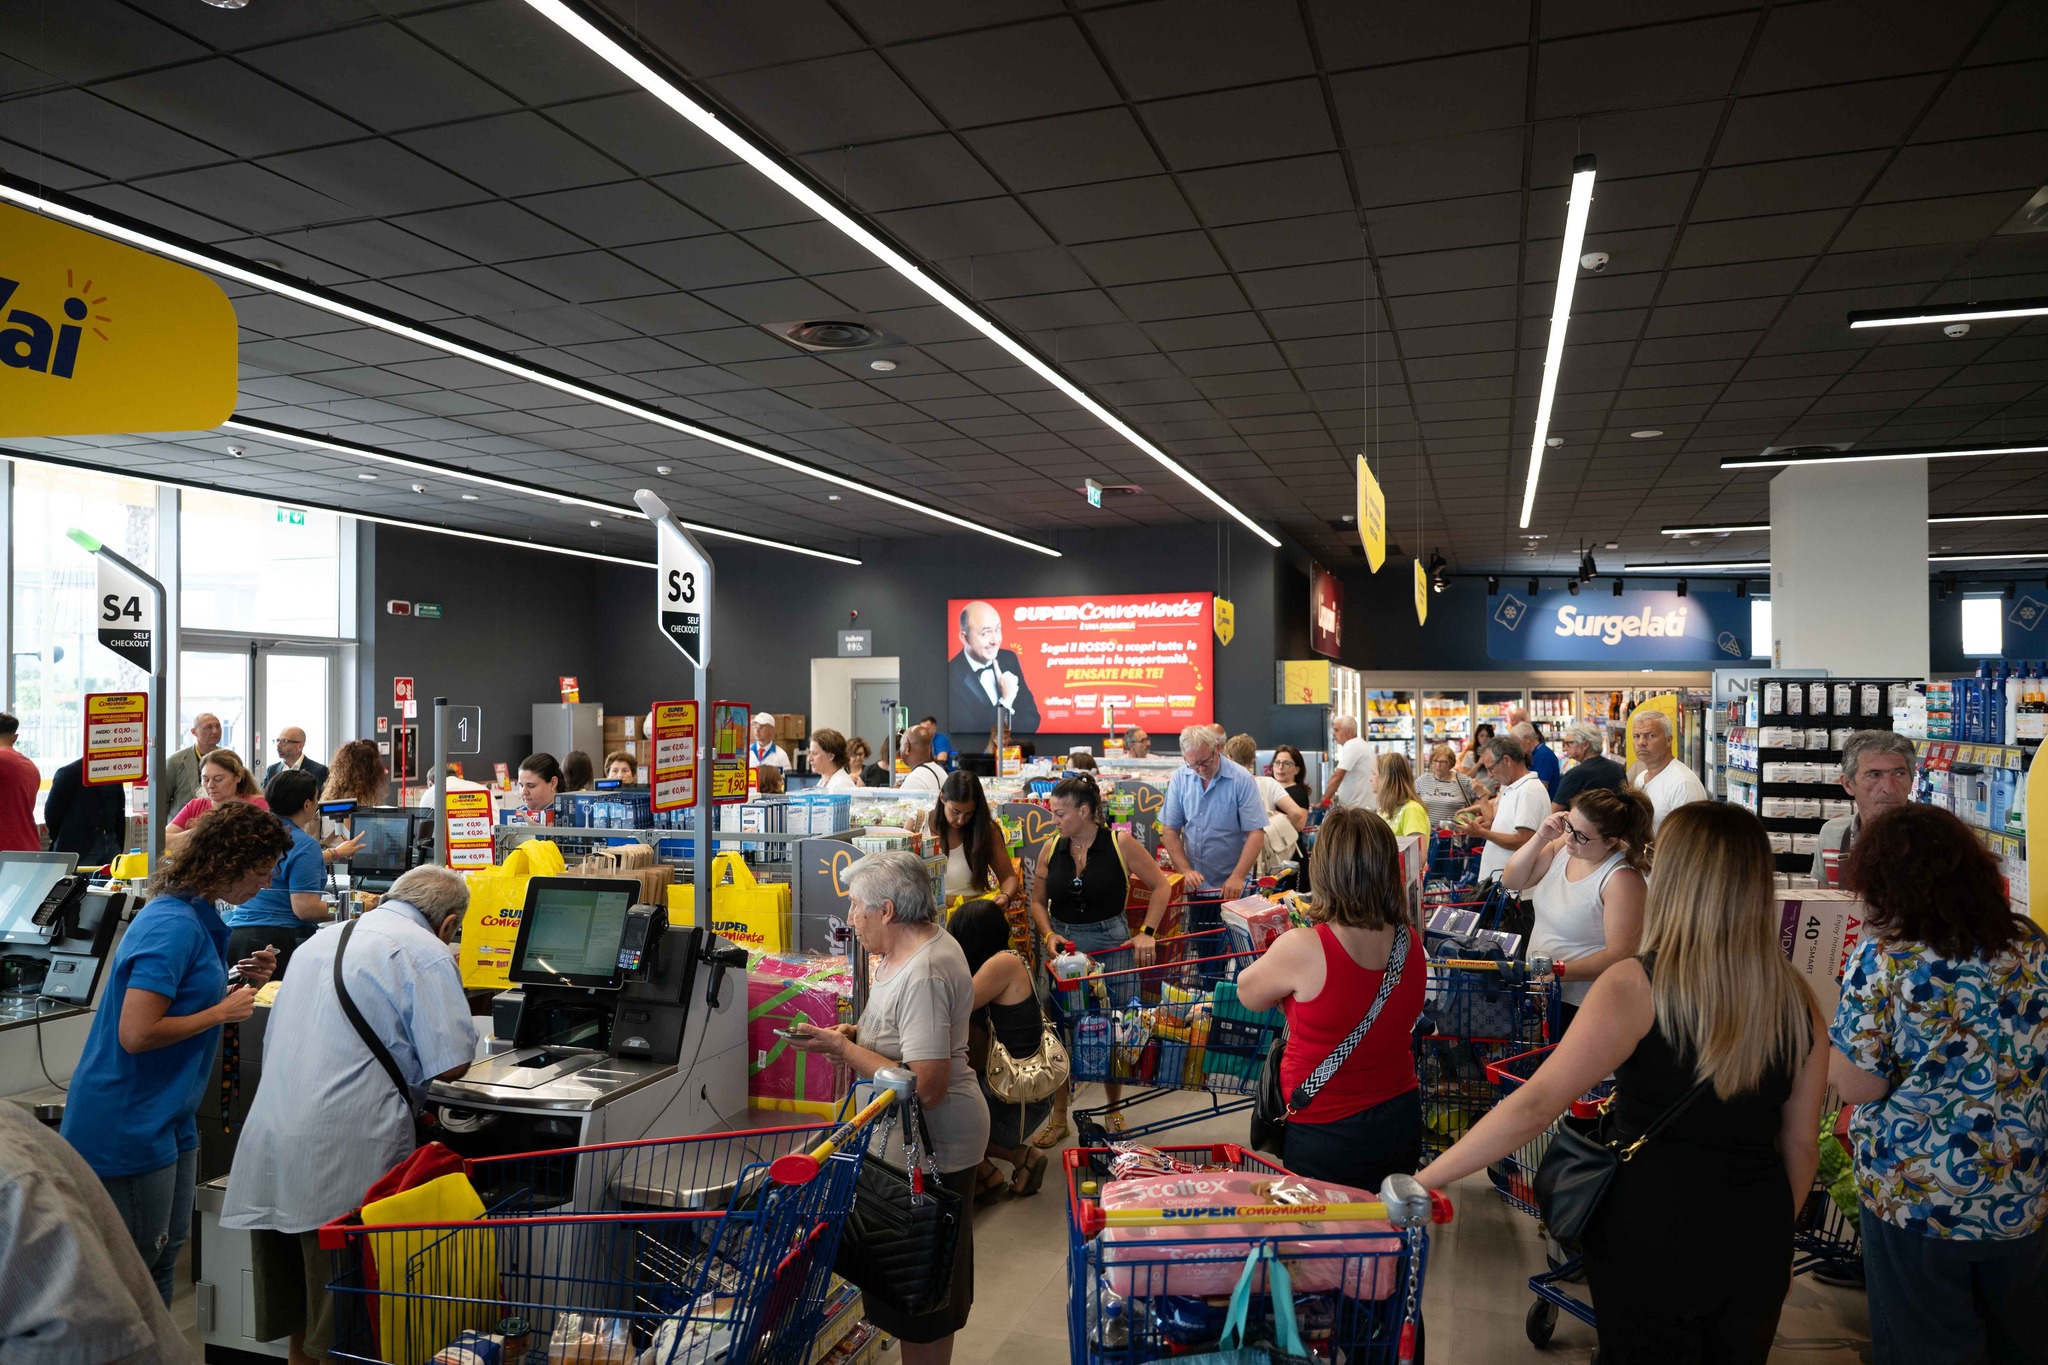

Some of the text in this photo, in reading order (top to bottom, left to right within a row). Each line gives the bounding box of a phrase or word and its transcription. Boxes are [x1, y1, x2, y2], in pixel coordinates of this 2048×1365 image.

[668, 569, 695, 604] S3
[102, 594, 142, 622] S4
[687, 616, 700, 625] SELF
[1555, 605, 1688, 645] Surgelati
[133, 632, 150, 640] SELF
[670, 624, 700, 634] CHECKOUT
[110, 639, 150, 648] CHECKOUT
[1040, 642, 1069, 655] Segui
[1078, 641, 1116, 652] ROSSO
[1116, 643, 1124, 652] e
[1124, 641, 1156, 654] scopri
[1156, 641, 1184, 652] tutte
[1186, 640, 1198, 651] le
[1046, 653, 1188, 668] promozioni e le opportunità
[1066, 667, 1165, 680] PENSATE PER TE!
[458, 717, 467, 742] 1
[1827, 914, 1844, 976] Enjoy Innovation
[1806, 945, 1817, 976] SMART
[1131, 1179, 1229, 1202] Scottex
[1158, 1196, 1211, 1207] L'Originale
